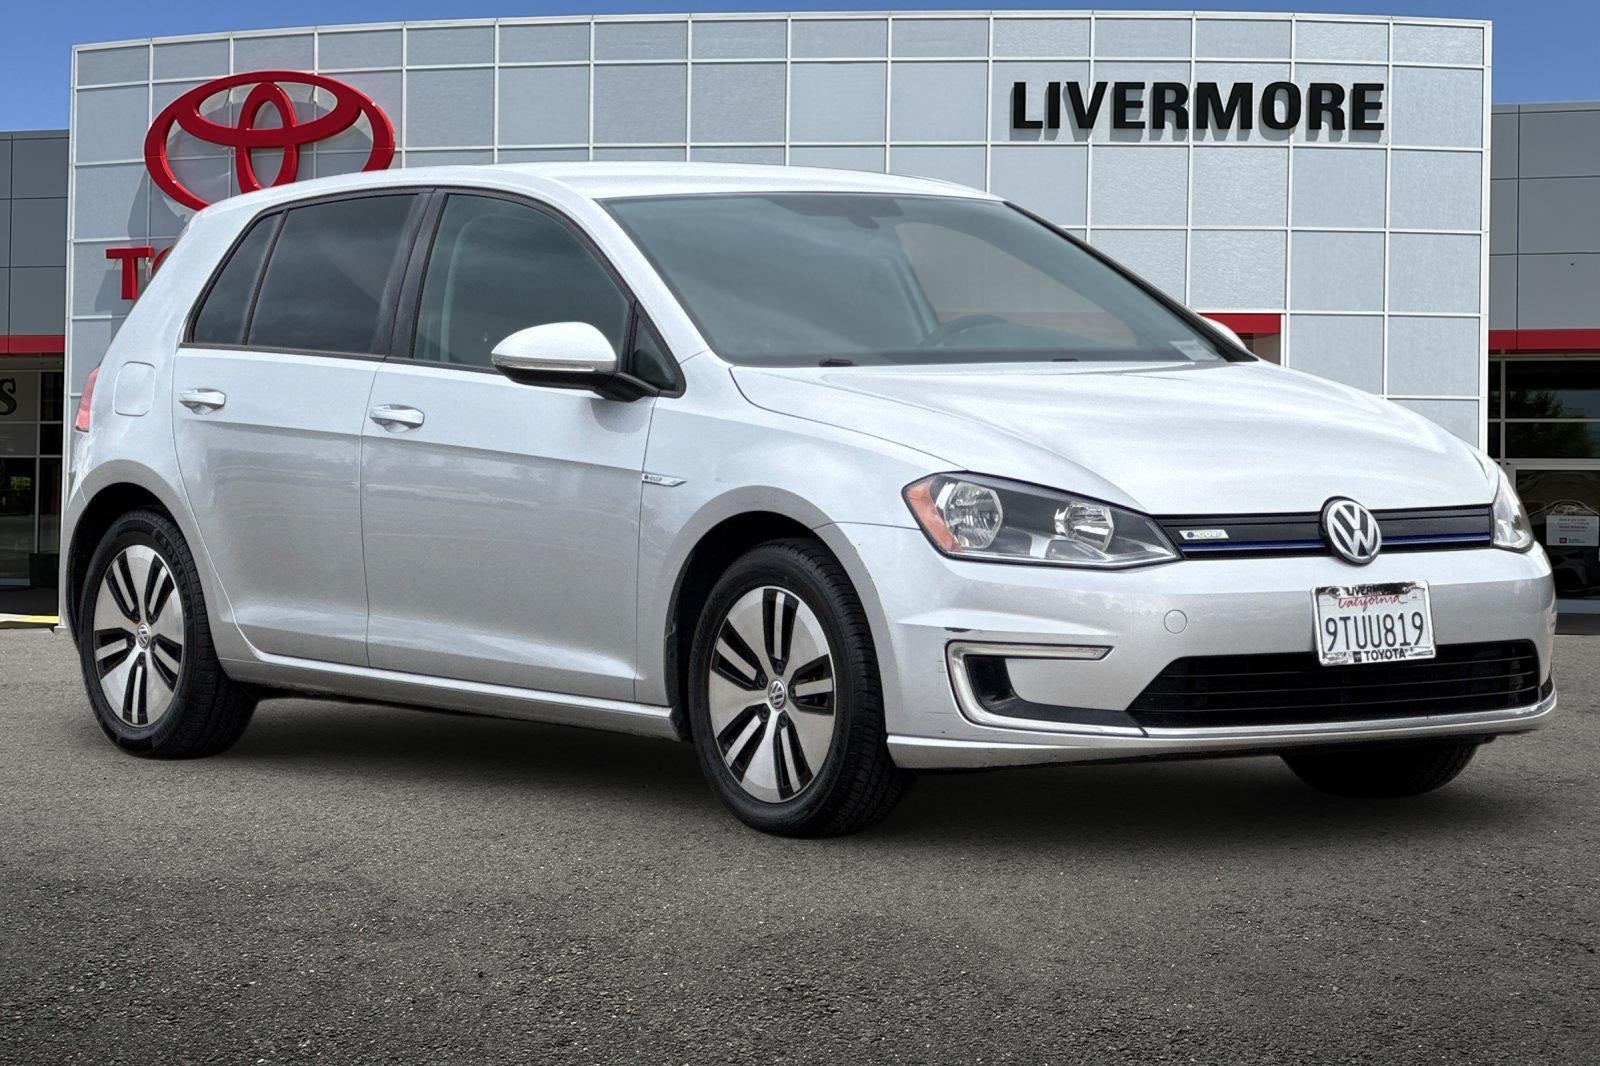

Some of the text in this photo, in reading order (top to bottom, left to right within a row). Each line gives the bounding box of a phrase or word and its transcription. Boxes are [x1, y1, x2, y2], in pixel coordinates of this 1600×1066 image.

[1012, 82, 1385, 130] LIVERMORE
[1325, 611, 1424, 652] 9TUU819
[1363, 647, 1406, 661] TOYOTA
